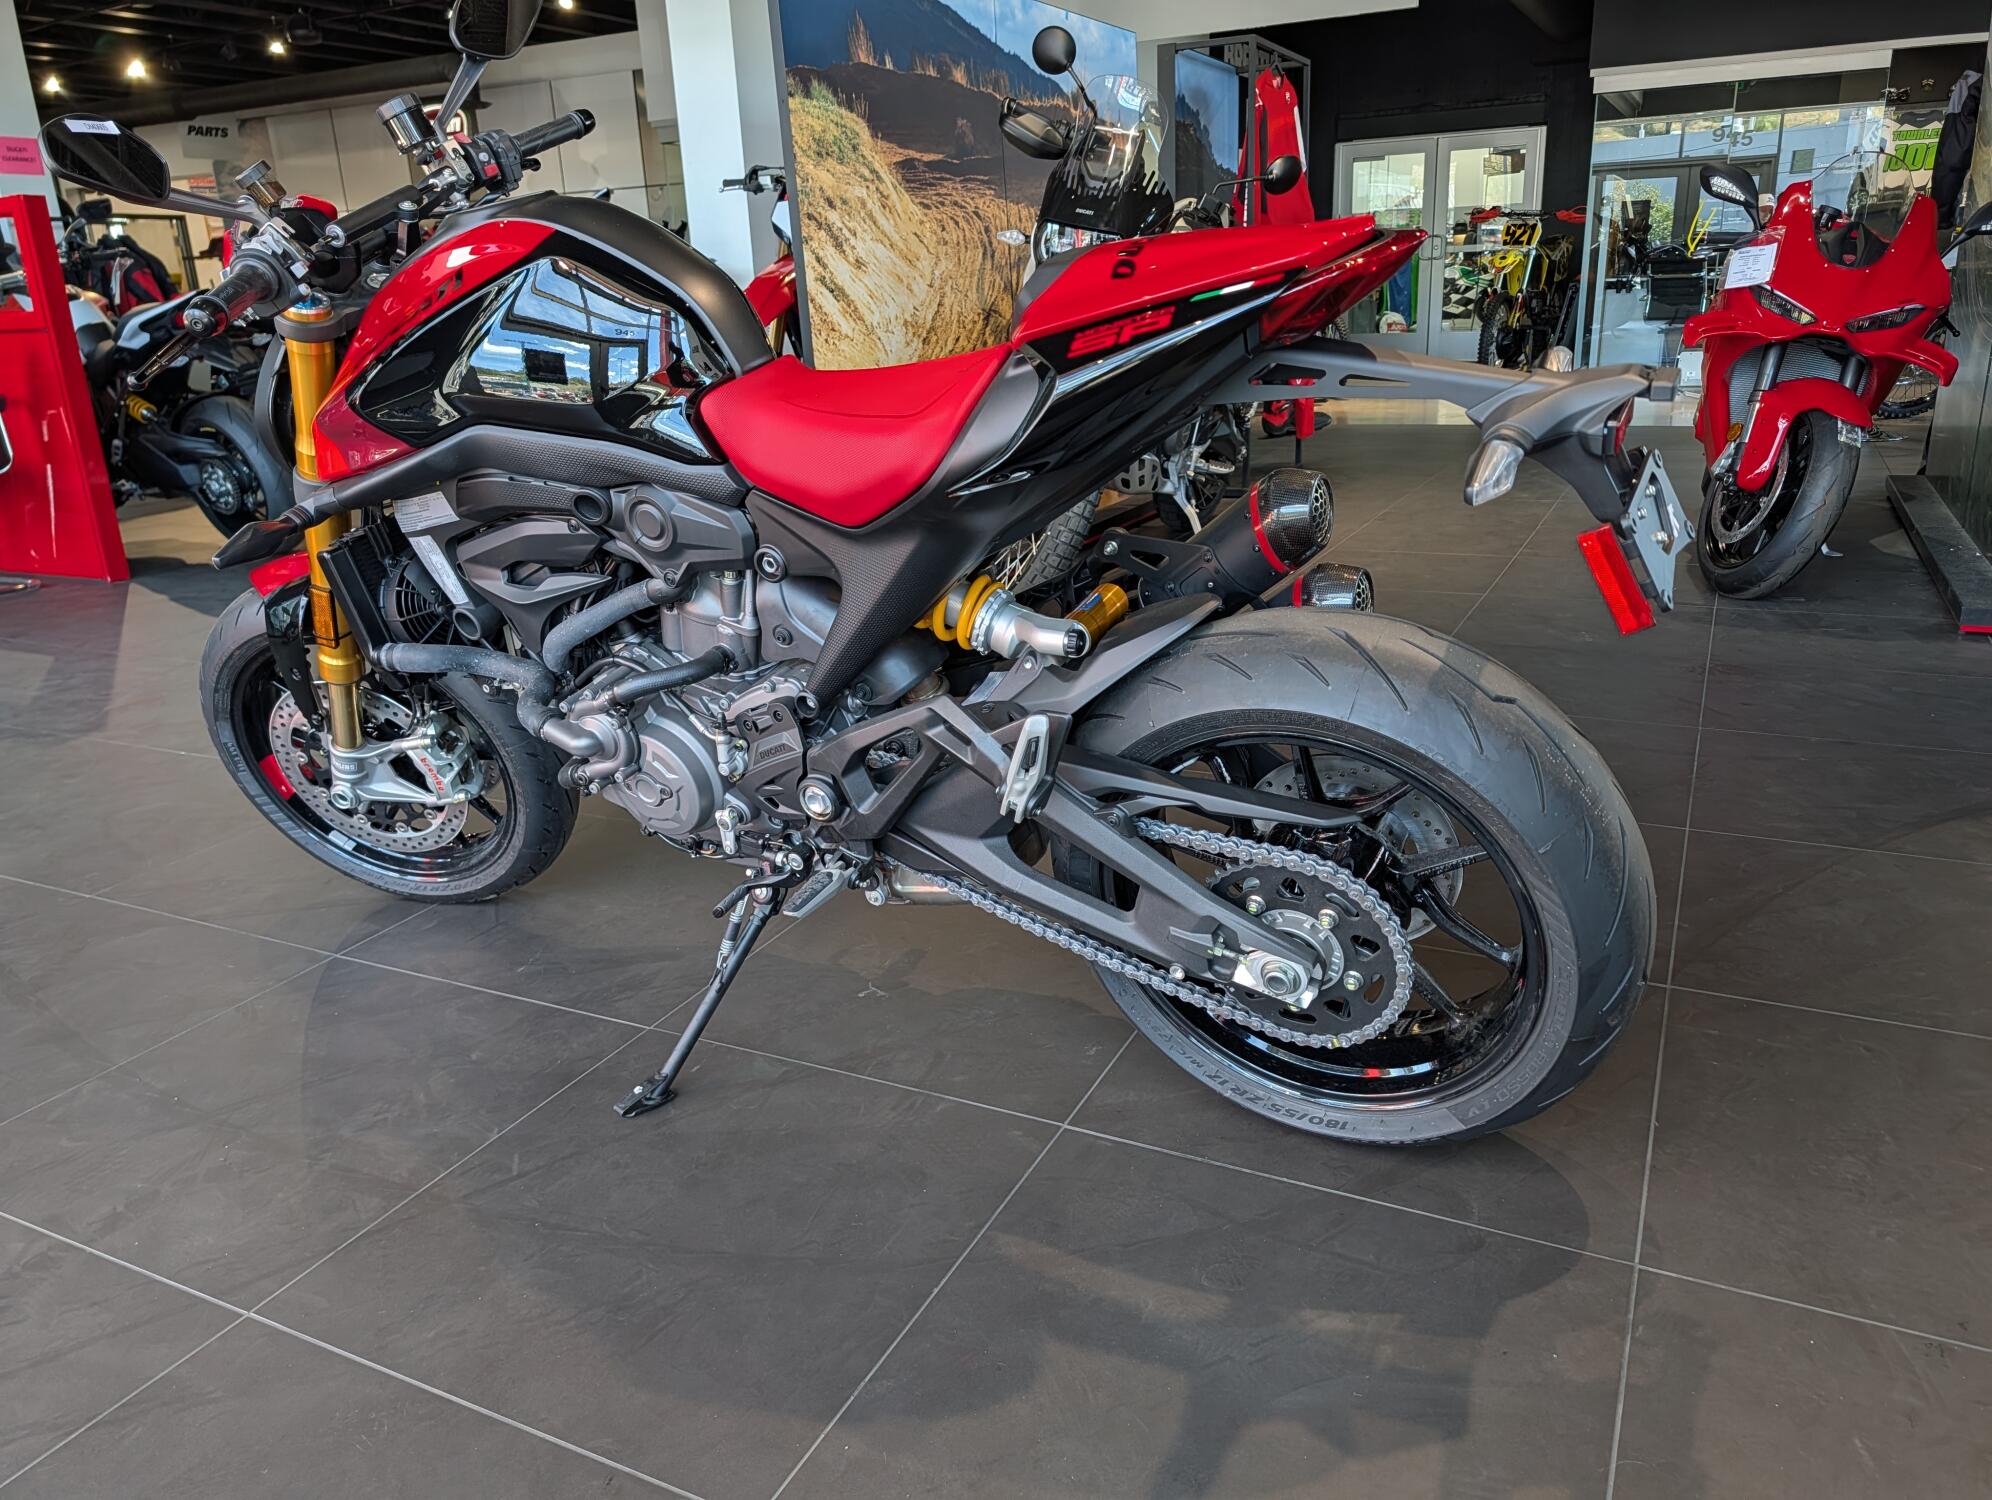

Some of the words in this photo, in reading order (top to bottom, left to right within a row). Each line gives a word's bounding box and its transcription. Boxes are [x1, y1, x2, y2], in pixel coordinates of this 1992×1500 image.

[187, 125, 229, 138] PARTS
[1712, 127, 1754, 147] 945
[1892, 127, 1942, 141] TOWNLE
[1075, 207, 1094, 215] DUCATI
[1067, 313, 1174, 359] SP
[759, 743, 787, 760] DUCATI
[420, 755, 446, 793] brembo
[1268, 1102, 1349, 1131] 180/55
